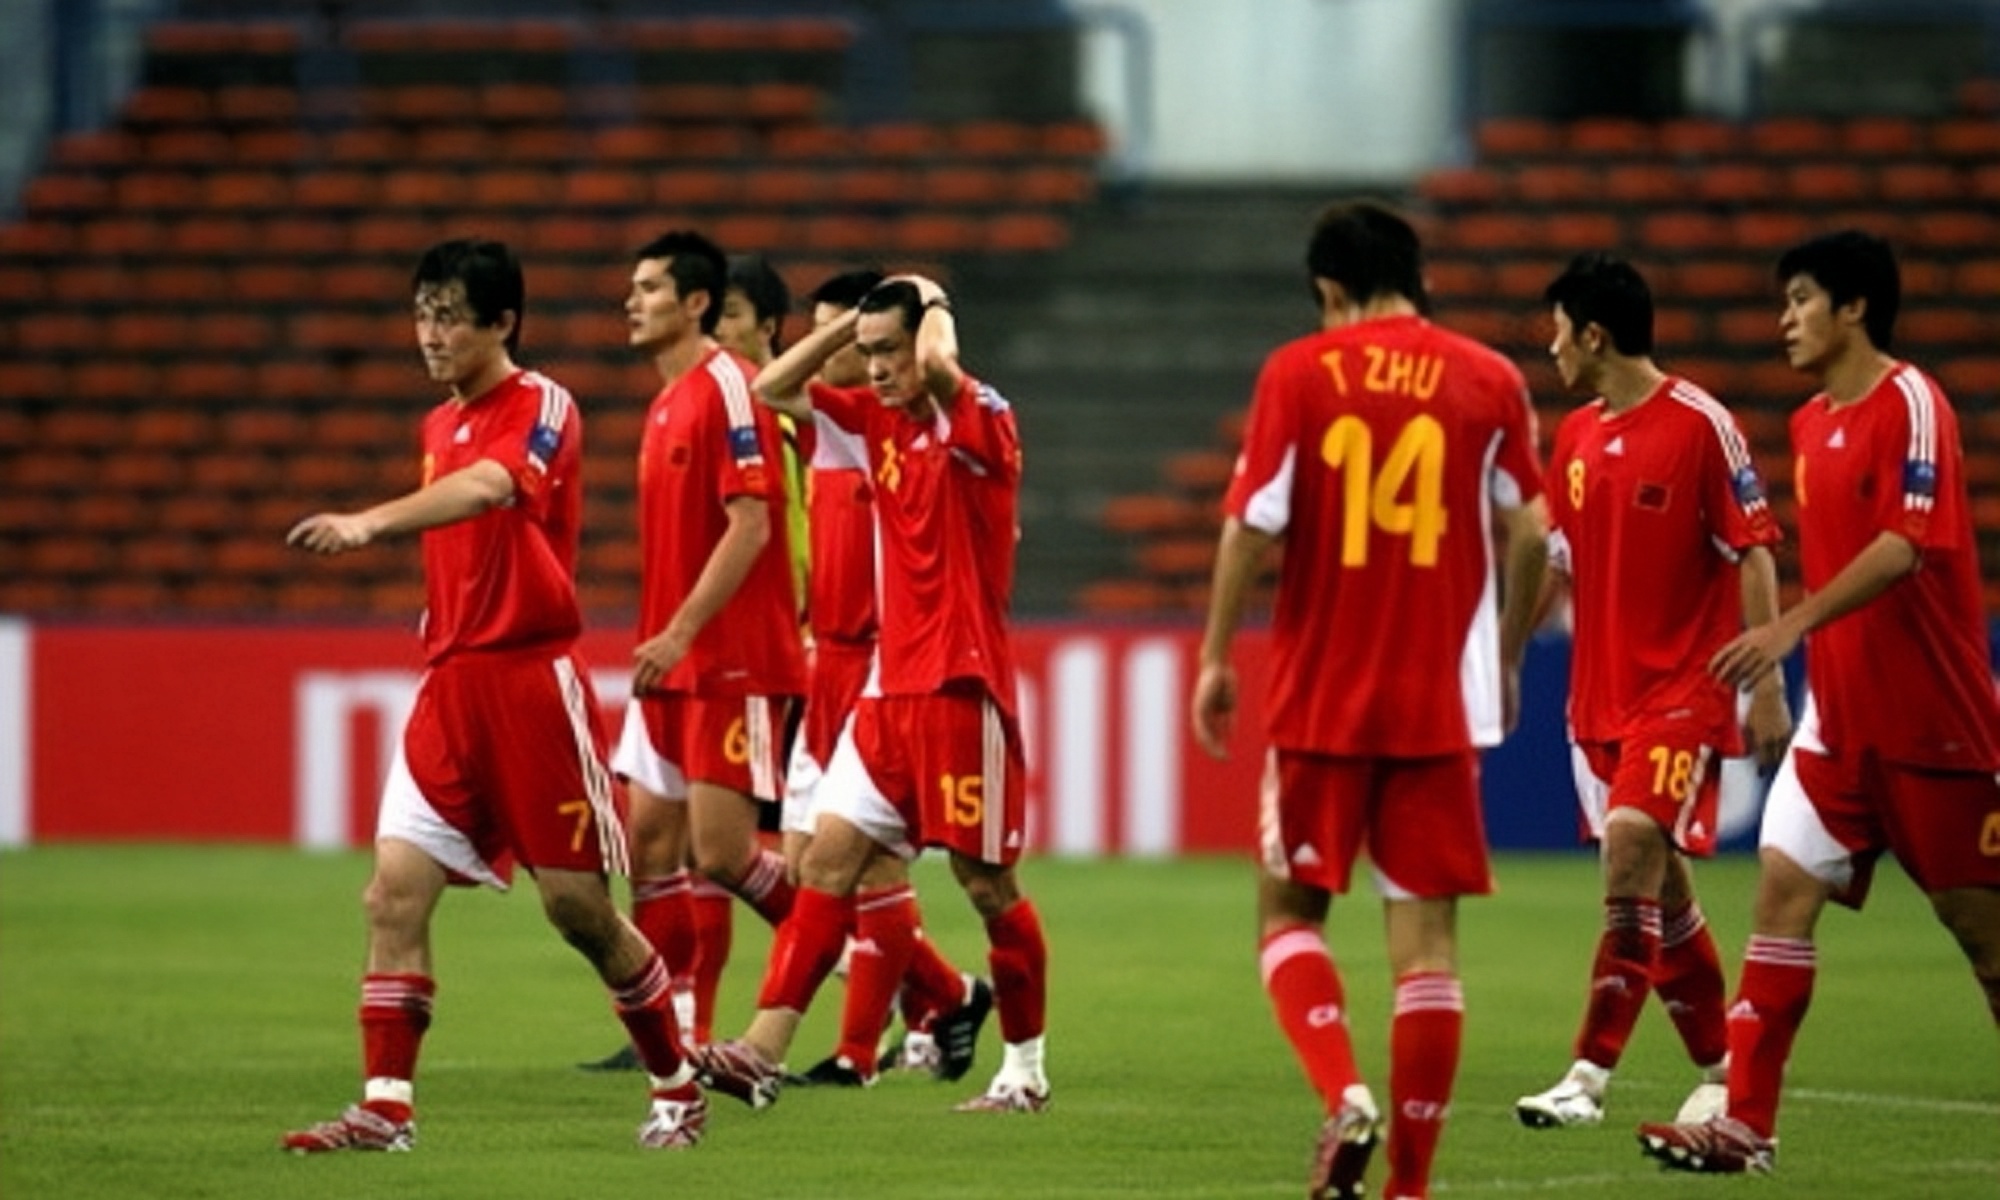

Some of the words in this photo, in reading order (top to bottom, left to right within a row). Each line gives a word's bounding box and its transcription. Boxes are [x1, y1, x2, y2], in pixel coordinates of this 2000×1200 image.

[1321, 350, 1347, 396] T
[1364, 346, 1444, 399] ZHU
[1321, 414, 1447, 567] 14
[723, 717, 748, 763] 6
[1649, 746, 1695, 801] 18
[940, 774, 984, 826] 15
[558, 801, 594, 852] 7
